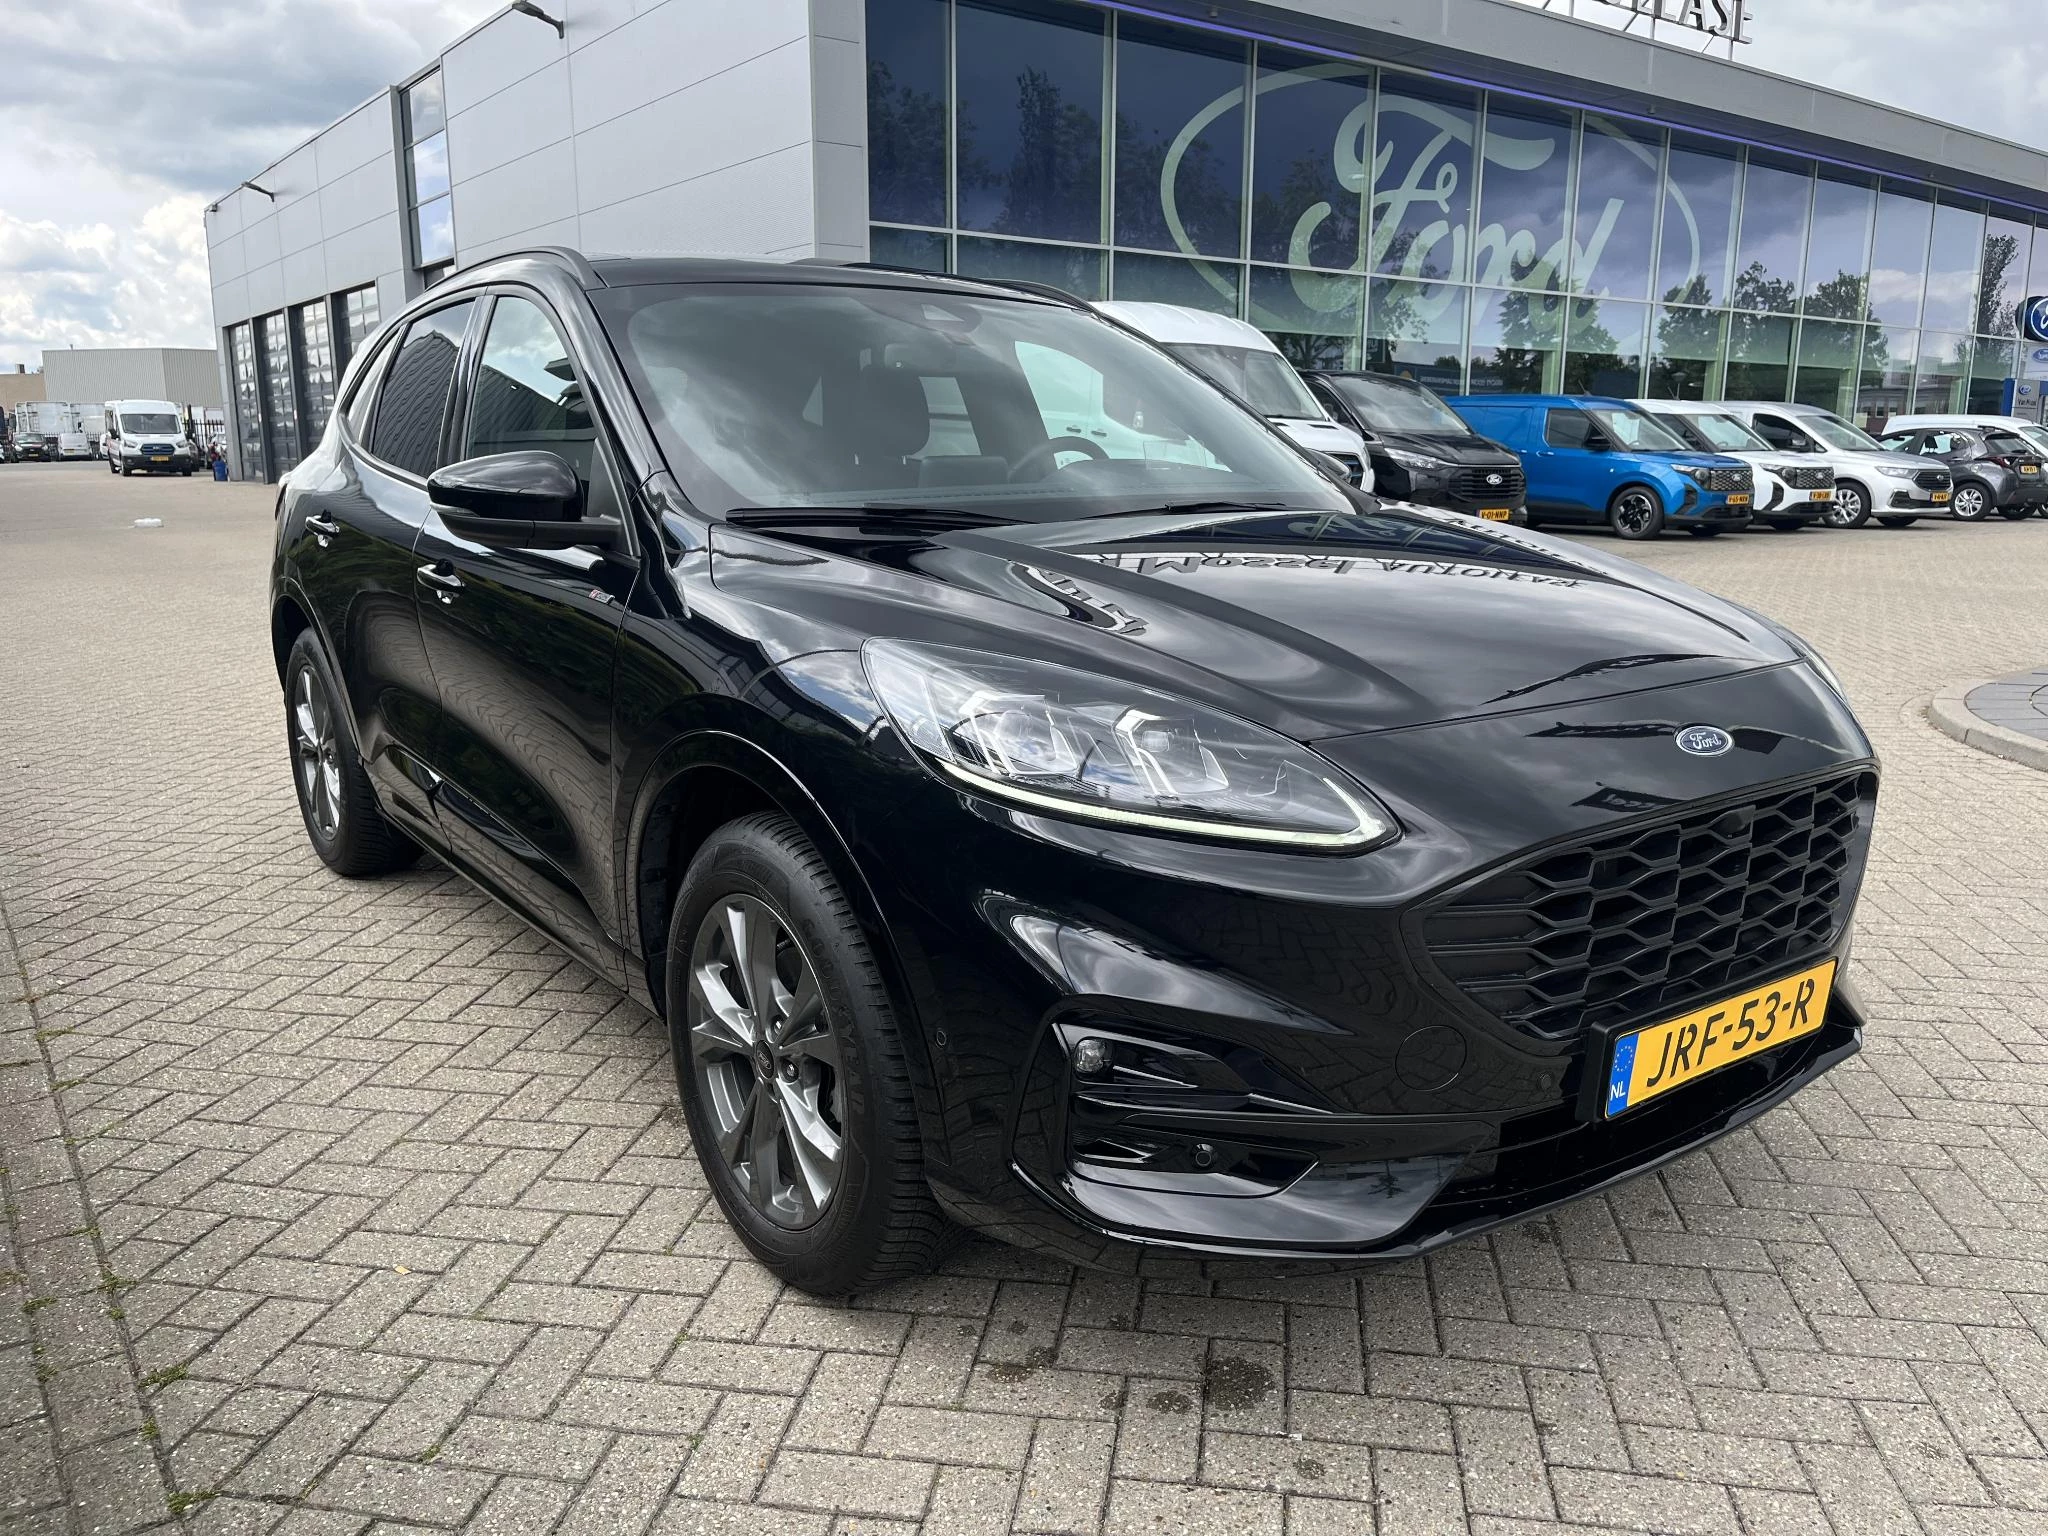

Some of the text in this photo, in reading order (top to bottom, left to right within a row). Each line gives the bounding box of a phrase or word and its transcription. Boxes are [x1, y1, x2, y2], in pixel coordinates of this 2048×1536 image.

[1288, 94, 1625, 336] Ford
[1689, 731, 1722, 750] Ford
[1646, 978, 1815, 1088] JRF-53-R
[1609, 1080, 1627, 1101] NL
